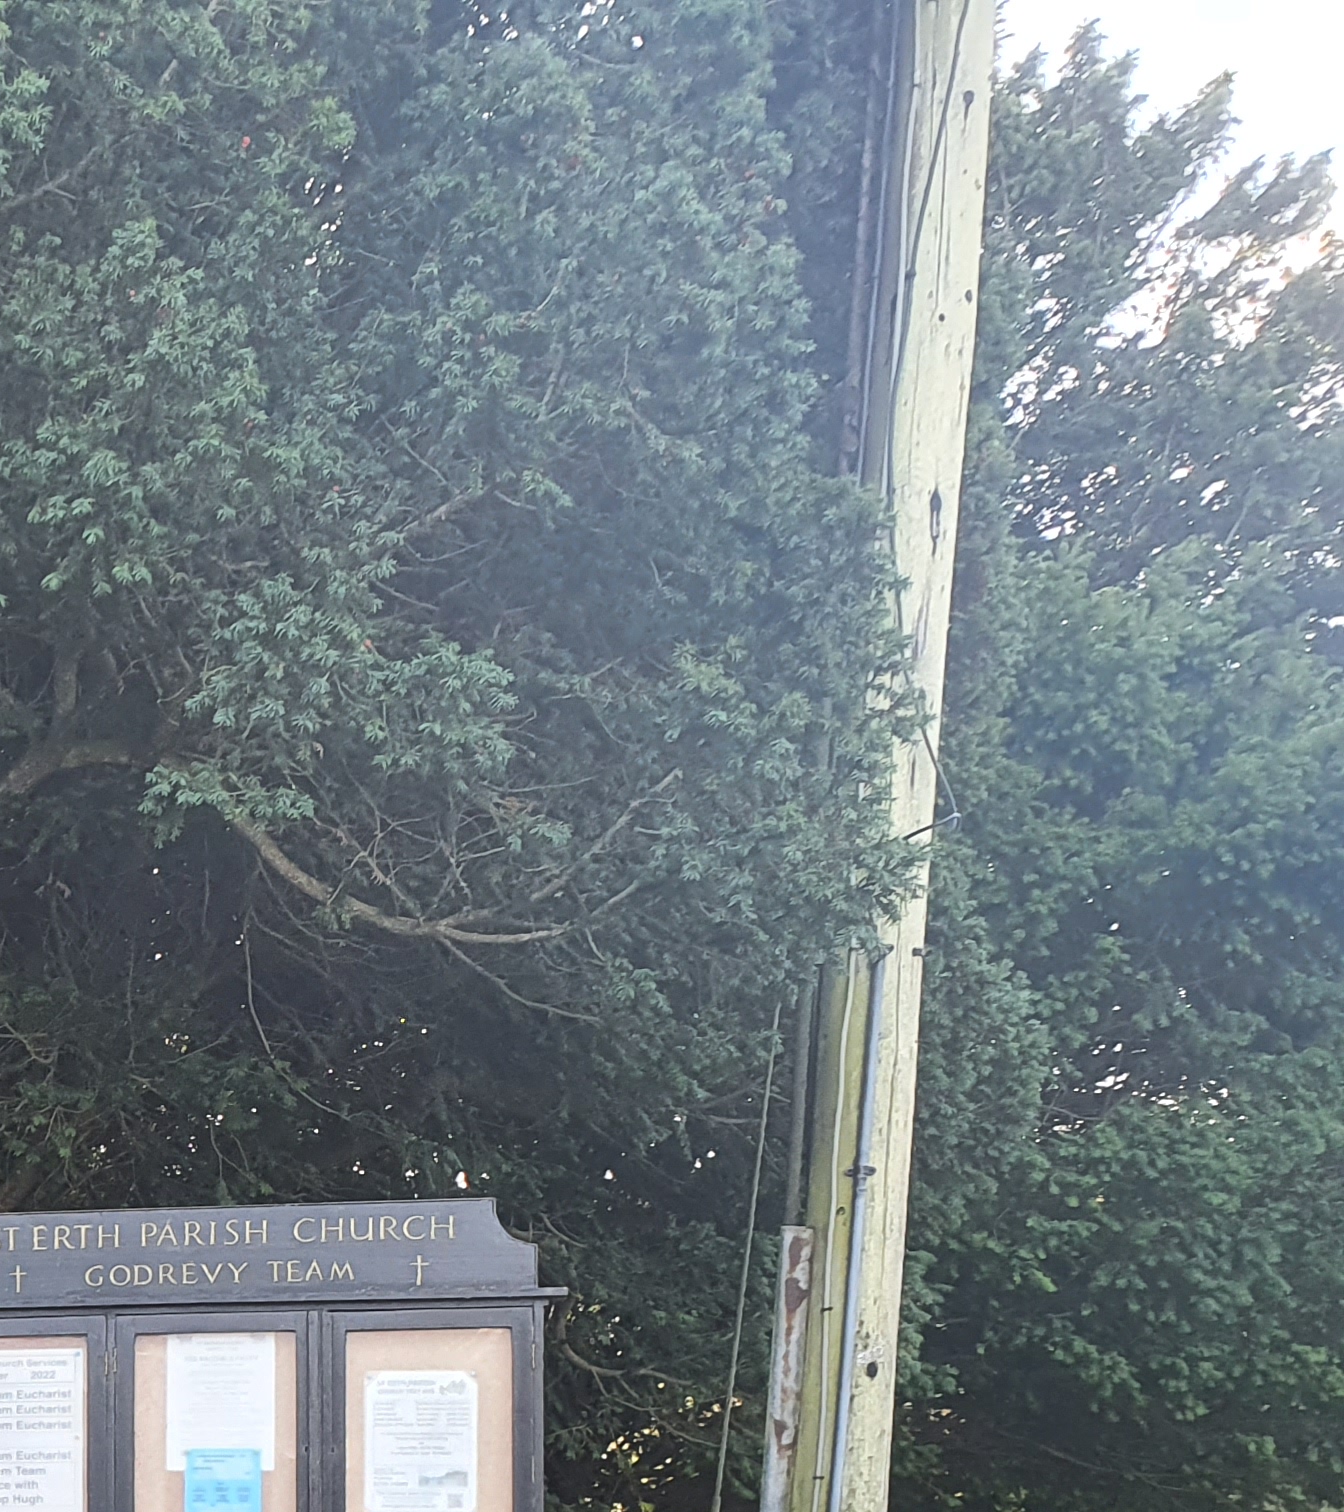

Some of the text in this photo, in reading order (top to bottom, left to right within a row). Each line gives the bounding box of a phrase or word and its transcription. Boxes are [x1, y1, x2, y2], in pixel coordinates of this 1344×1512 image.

[32, 1222, 121, 1251] ERTH
[140, 1218, 269, 1247] PARISH
[292, 1213, 457, 1244] CHURCH
[84, 1259, 356, 1288] GODREVY TEAM
[26, 1358, 68, 1367] Services
[30, 1370, 56, 1380] 2022
[16, 1389, 72, 1399] Eucharist
[16, 1404, 72, 1414] Eucharist
[16, 1419, 72, 1429] Eucharist
[16, 1450, 72, 1460] Eucharist
[16, 1466, 46, 1475] Team
[15, 1480, 39, 1489] with
[13, 1494, 44, 1505] Hugh
